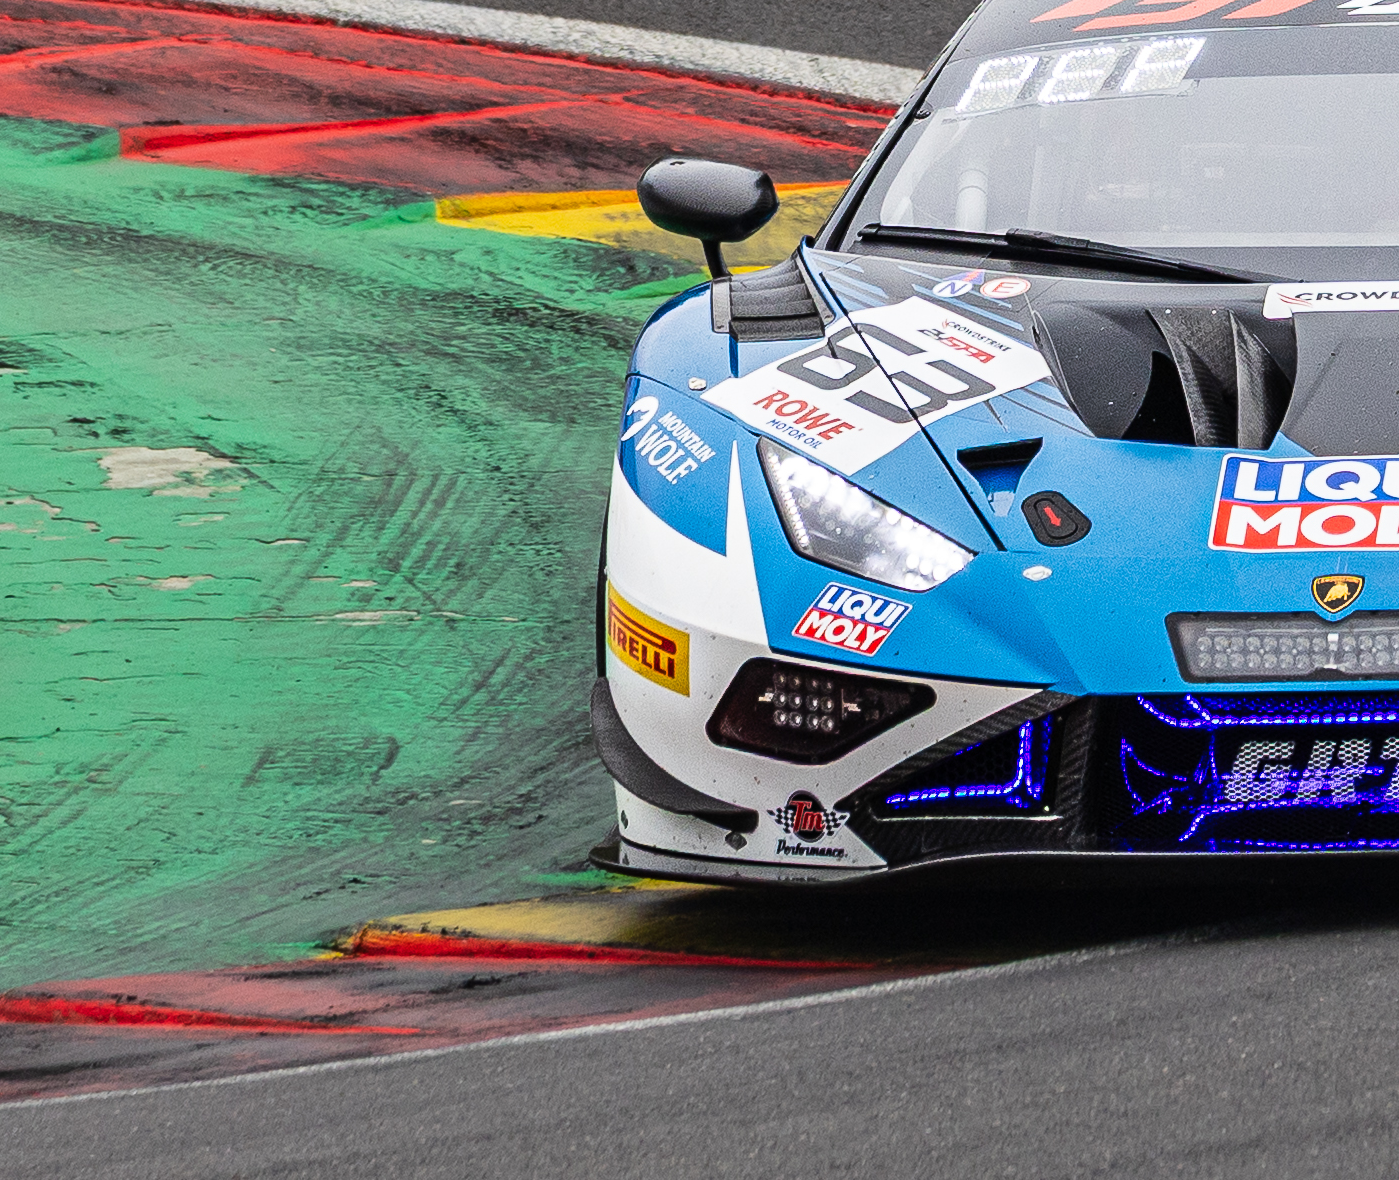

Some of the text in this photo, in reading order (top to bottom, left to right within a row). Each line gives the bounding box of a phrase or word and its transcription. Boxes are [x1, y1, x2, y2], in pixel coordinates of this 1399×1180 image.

[777, 323, 996, 424] 63
[658, 411, 716, 463] MOUNTAIN
[753, 389, 856, 441] ROWE
[766, 418, 807, 441] MOTOR
[798, 610, 889, 651] MOLY
[817, 586, 906, 627] LIQUI
[608, 599, 677, 680] PIRELLI
